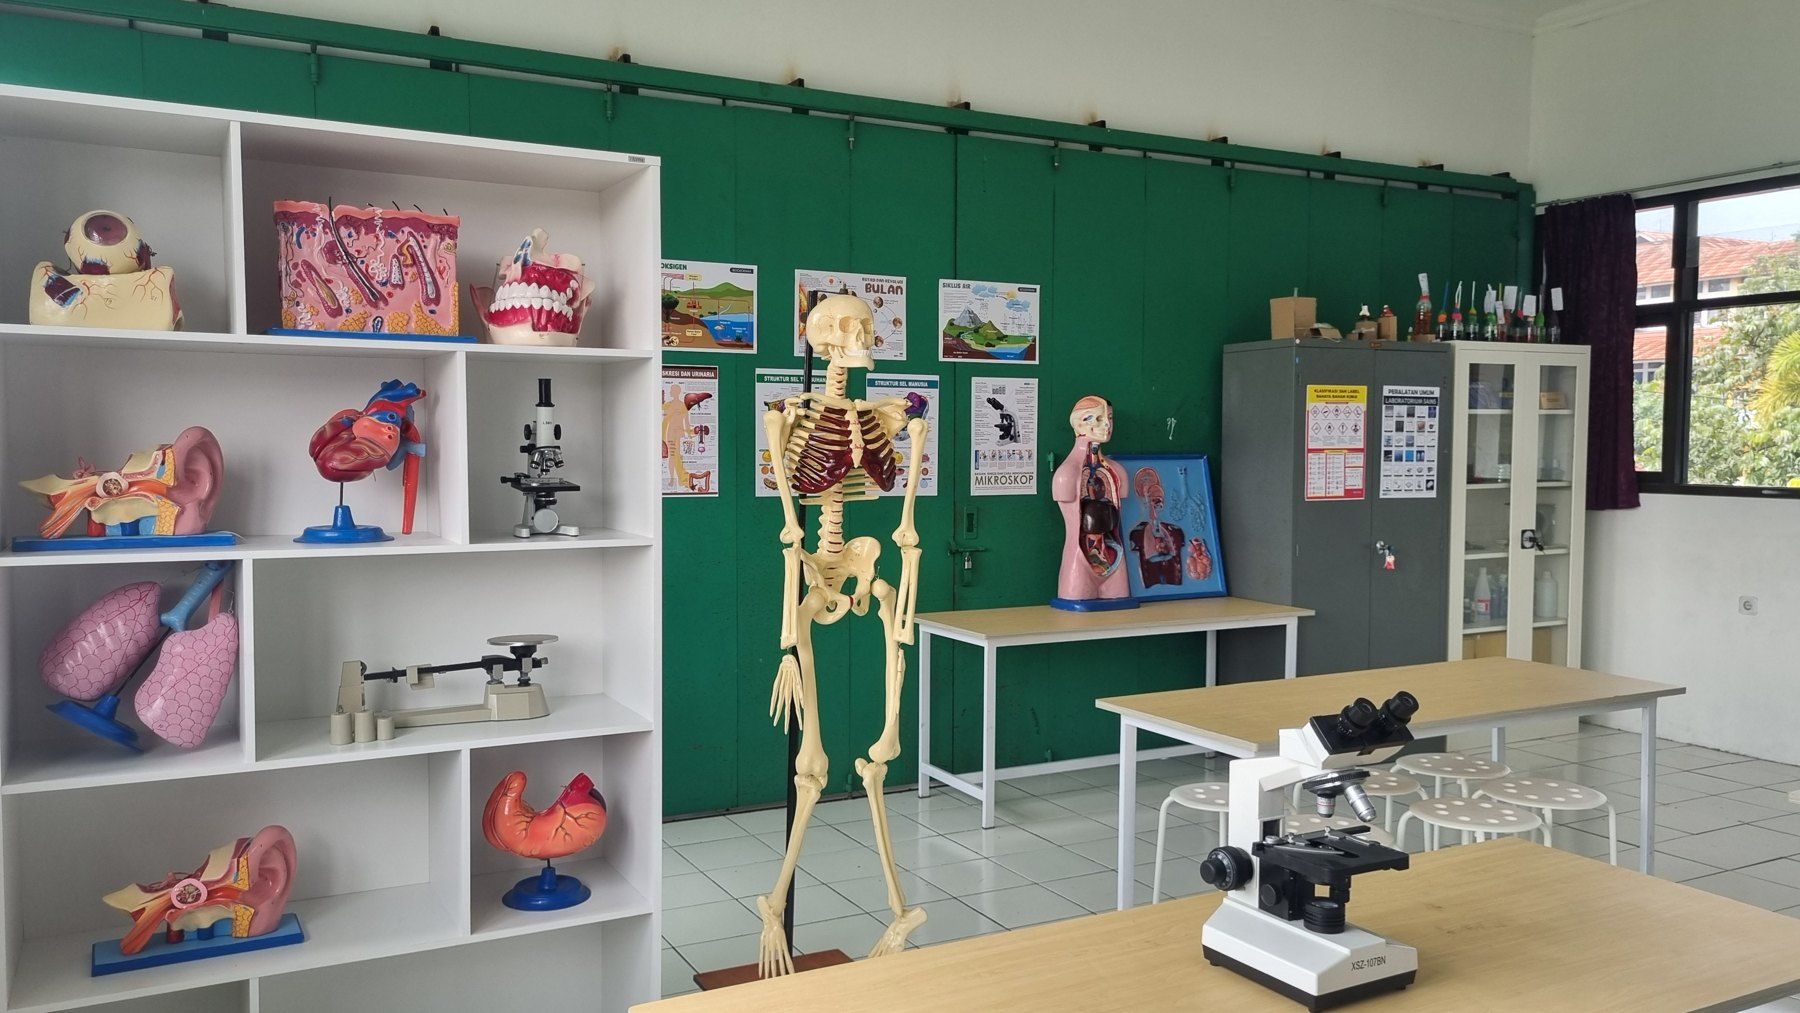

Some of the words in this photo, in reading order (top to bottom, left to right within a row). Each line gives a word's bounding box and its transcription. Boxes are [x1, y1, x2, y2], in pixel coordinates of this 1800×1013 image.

[865, 283, 903, 295] BULAN
[975, 475, 1034, 485] MIKROSKOP
[1351, 956, 1386, 971] XSZ-107BN
